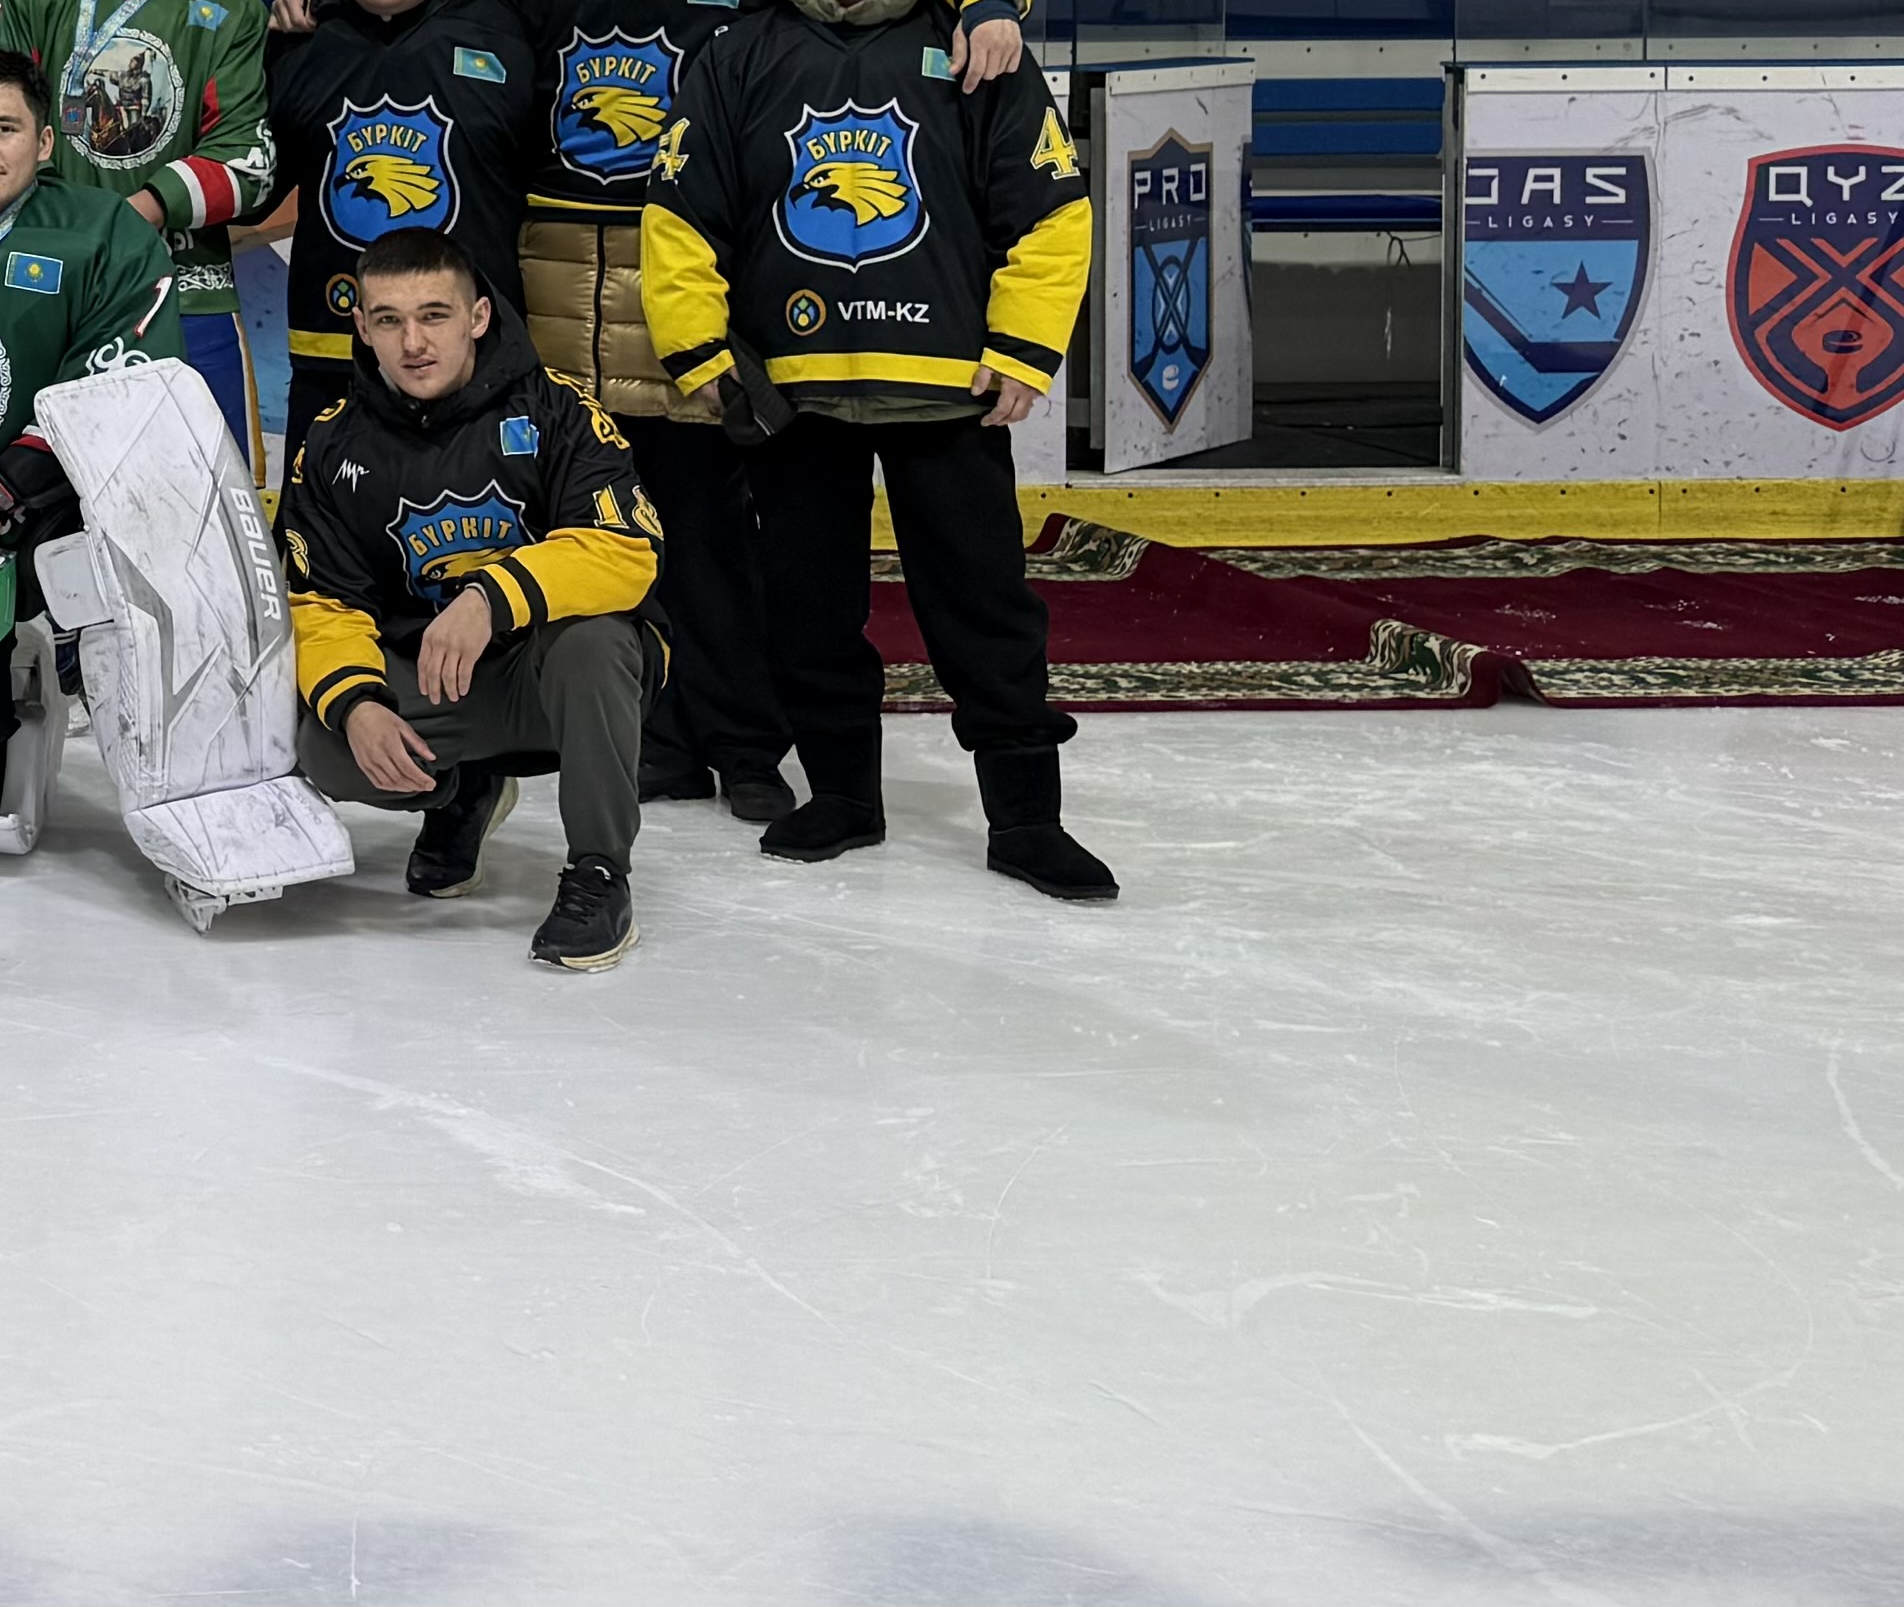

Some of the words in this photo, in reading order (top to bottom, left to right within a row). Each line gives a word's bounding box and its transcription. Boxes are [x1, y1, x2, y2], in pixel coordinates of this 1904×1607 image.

[576, 57, 656, 85] БҮРКІТ
[347, 125, 429, 154] БҮРКІТ
[806, 130, 893, 160] БҮРКІТ
[1134, 161, 1207, 210] PRO
[1488, 214, 1596, 230] LIGASY
[1791, 212, 1898, 226] LIGASY
[837, 300, 932, 325] VTM-KZ
[408, 515, 513, 558] БҮРКІТ
[232, 486, 282, 622] BAUER
